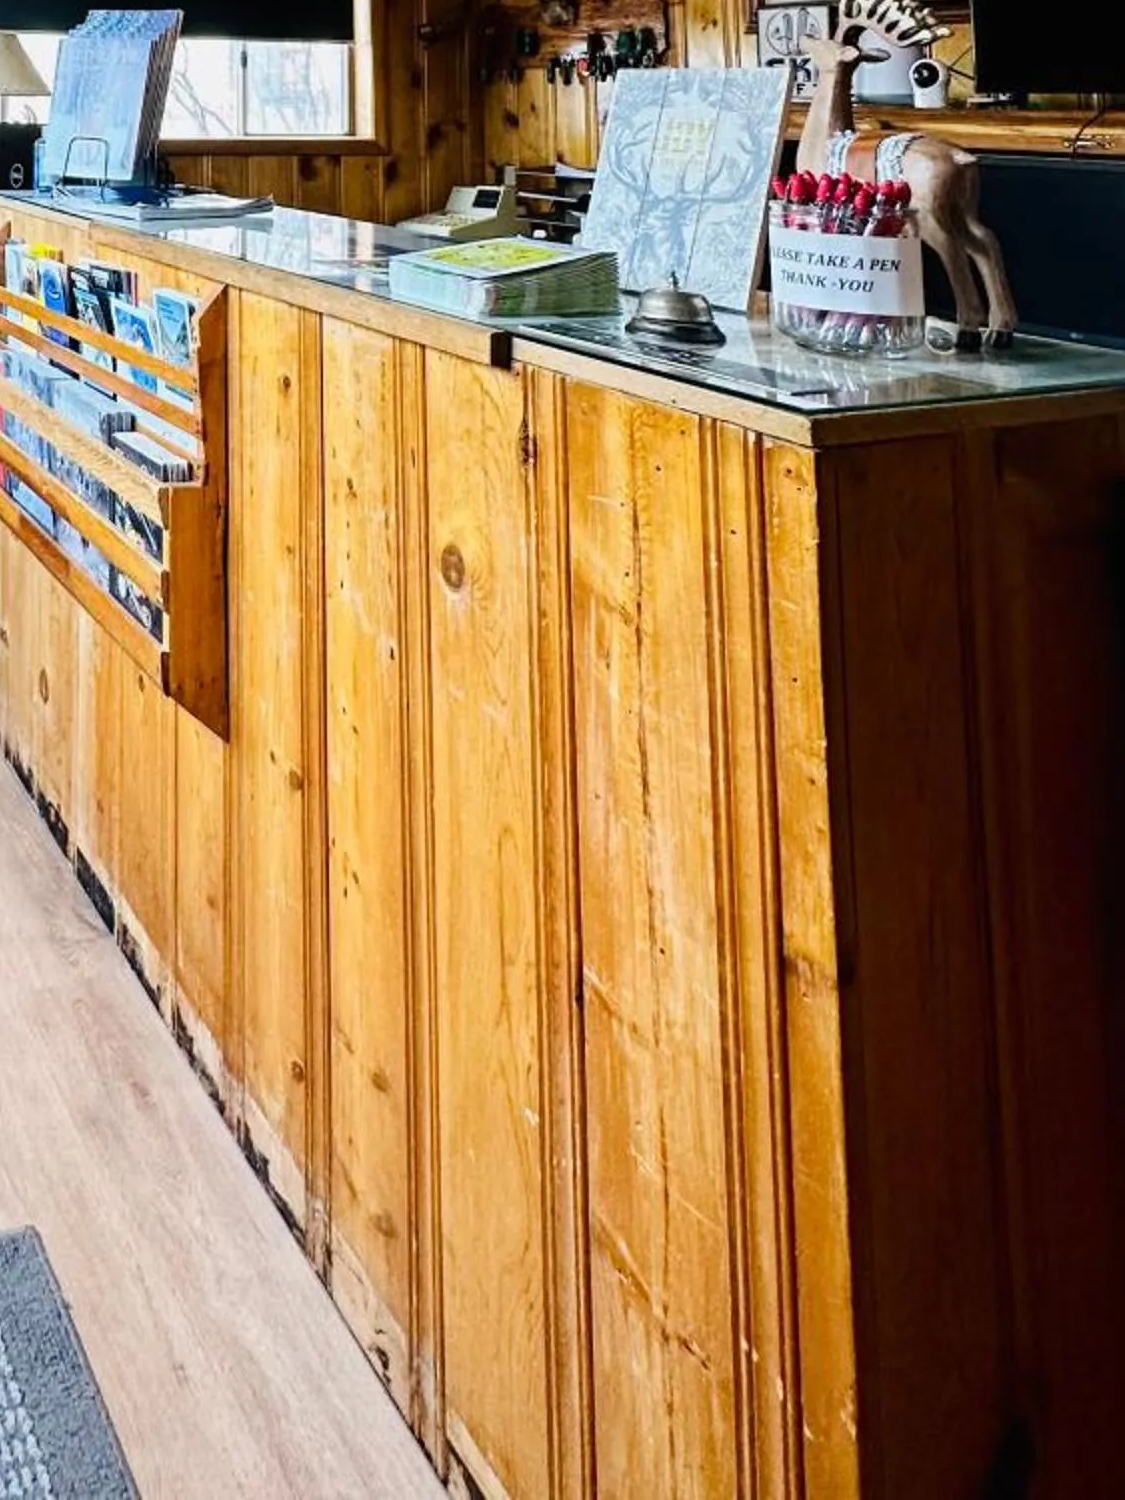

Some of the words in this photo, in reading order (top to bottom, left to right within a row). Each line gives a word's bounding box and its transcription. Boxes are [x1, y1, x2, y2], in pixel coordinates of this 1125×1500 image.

[807, 252, 851, 269] TAKE
[853, 257, 865, 271] A
[869, 258, 902, 273] PEN
[780, 269, 827, 289] THANK
